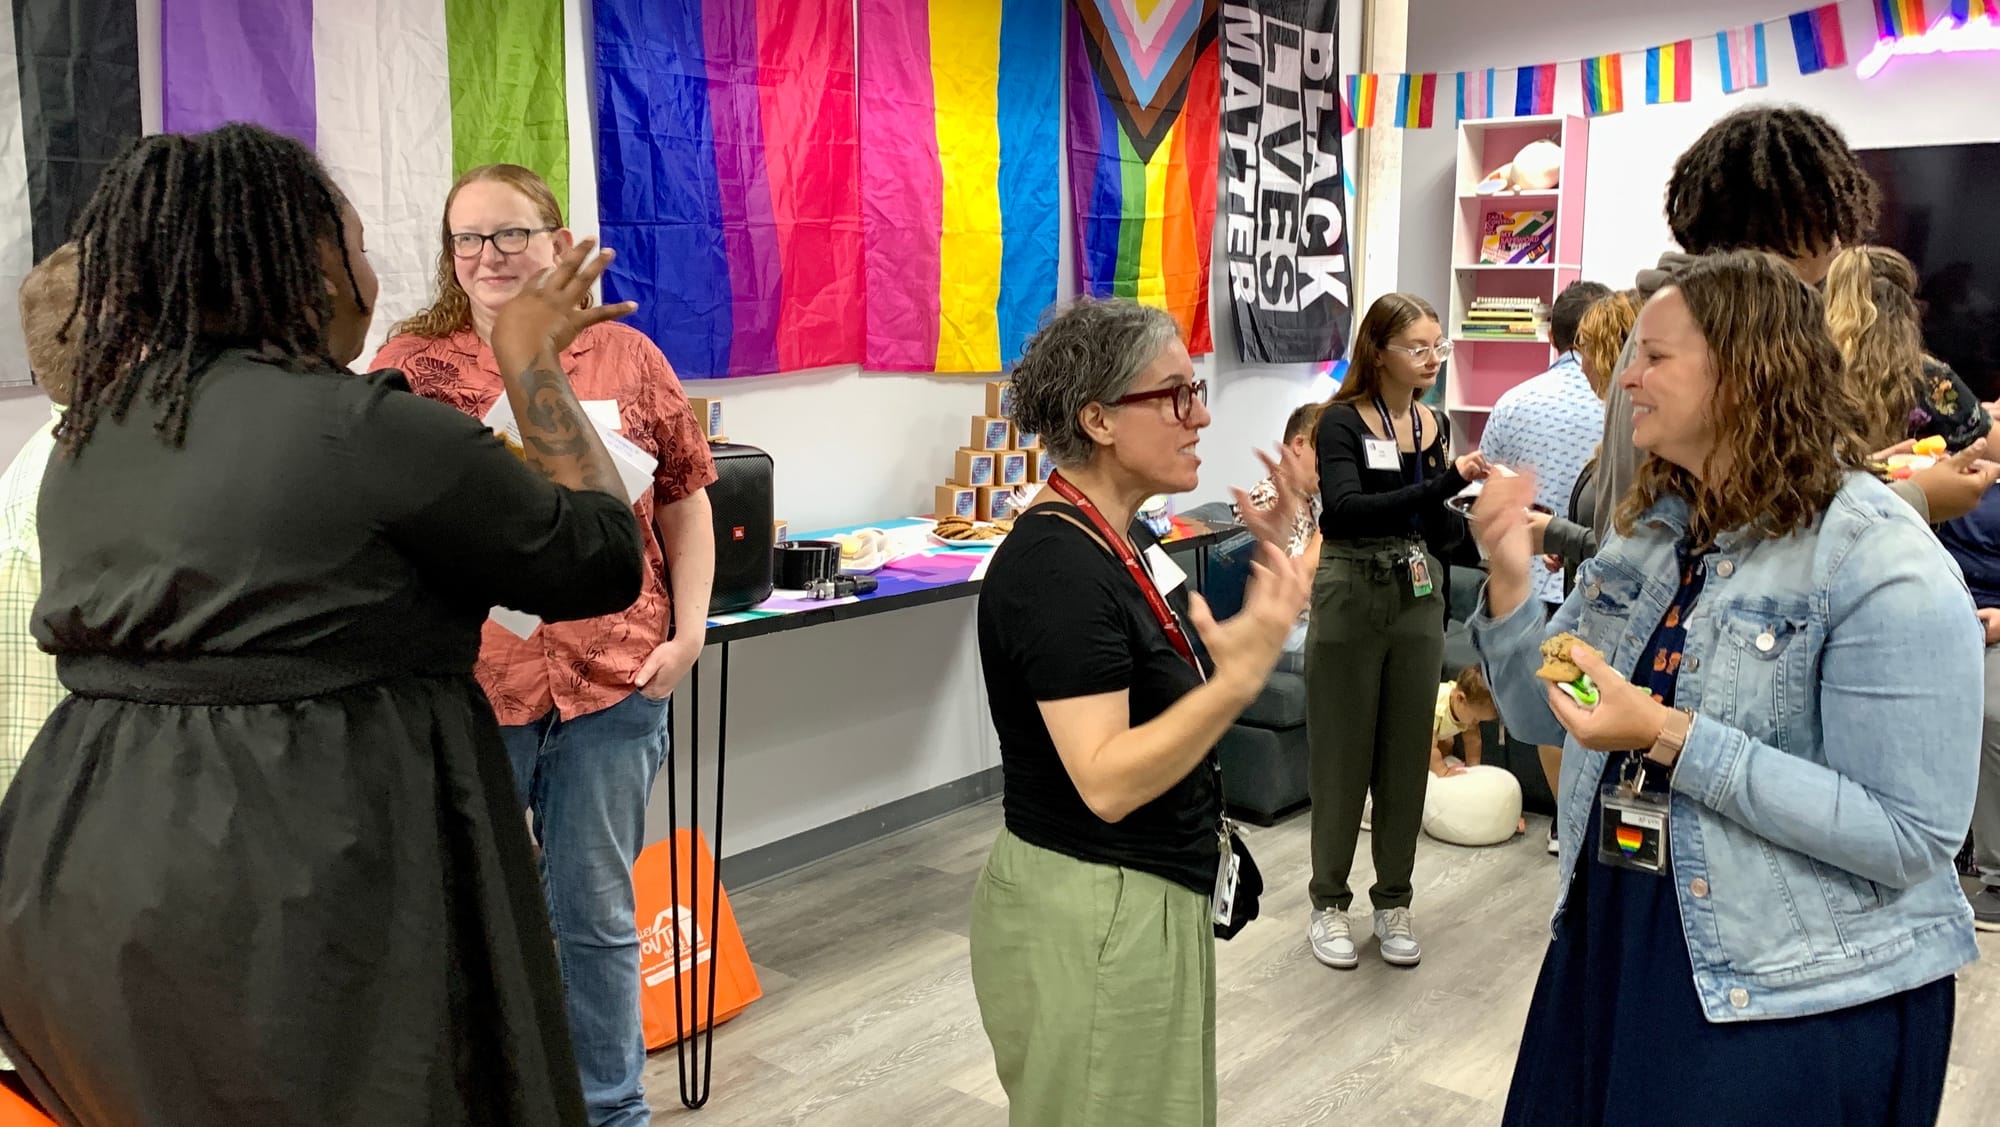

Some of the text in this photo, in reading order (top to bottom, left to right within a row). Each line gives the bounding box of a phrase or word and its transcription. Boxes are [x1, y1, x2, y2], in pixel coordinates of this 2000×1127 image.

[1223, 3, 1262, 305] MATTER
[1259, 20, 1302, 310] LIVES
[1299, 31, 1349, 310] BLACK
